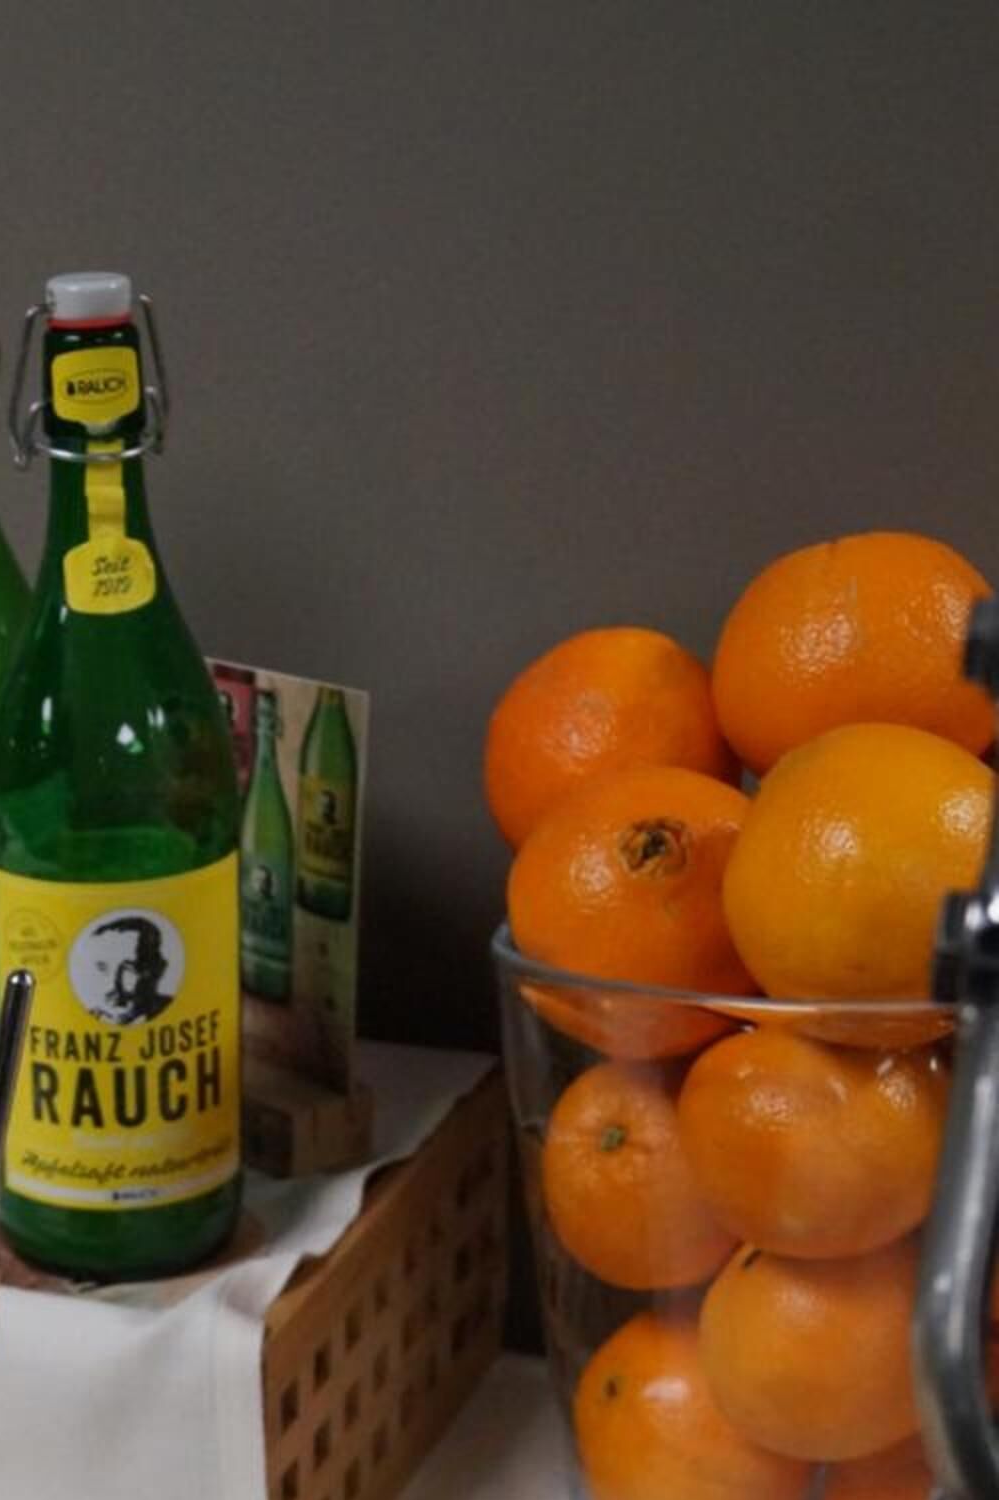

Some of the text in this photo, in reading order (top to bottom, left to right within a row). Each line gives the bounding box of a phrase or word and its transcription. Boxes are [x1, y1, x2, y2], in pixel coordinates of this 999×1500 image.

[74, 376, 127, 400] RAUCH
[29, 1023, 122, 1062] FRANZ
[138, 1009, 221, 1060] JOSEF
[31, 1046, 221, 1128] RAUCH
